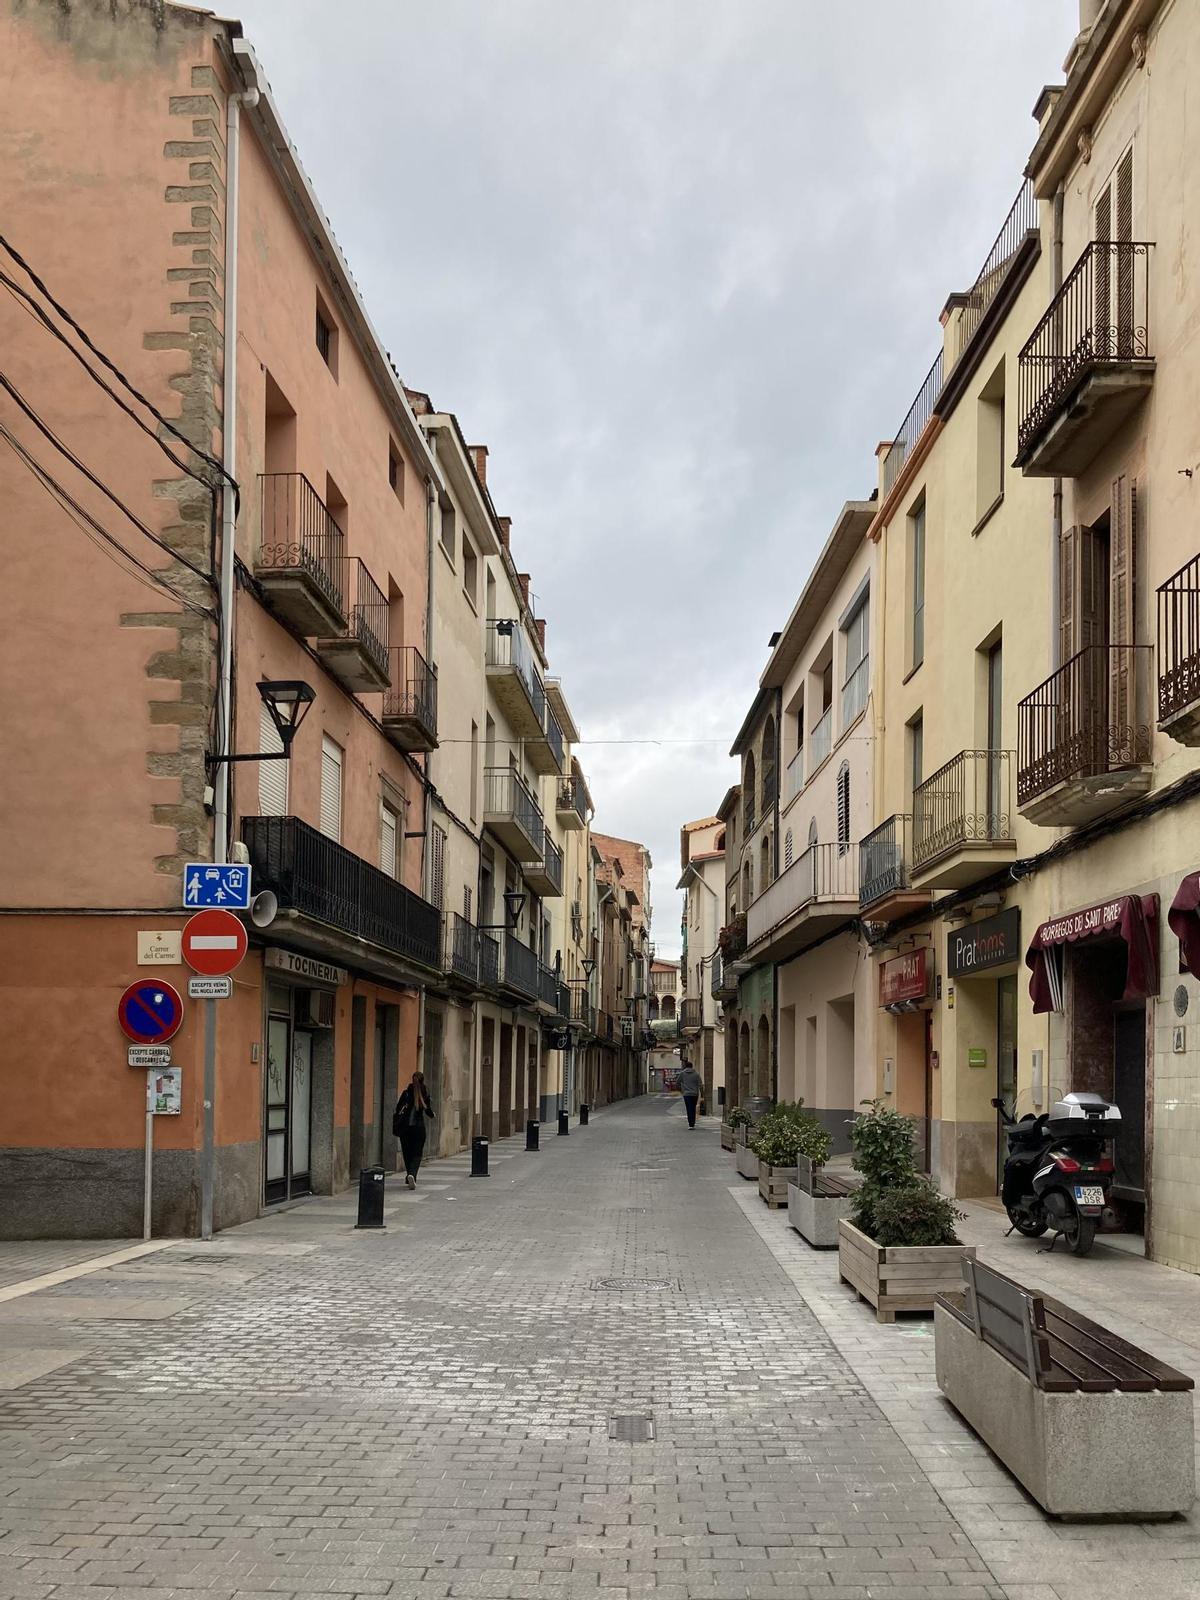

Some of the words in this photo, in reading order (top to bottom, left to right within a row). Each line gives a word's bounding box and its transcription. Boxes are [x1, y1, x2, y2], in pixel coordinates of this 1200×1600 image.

[1084, 908, 1102, 929] SANT
[287, 954, 339, 983] TOCINERIA
[1082, 1187, 1102, 1197] 4226
[1084, 1196, 1102, 1204] DSR
